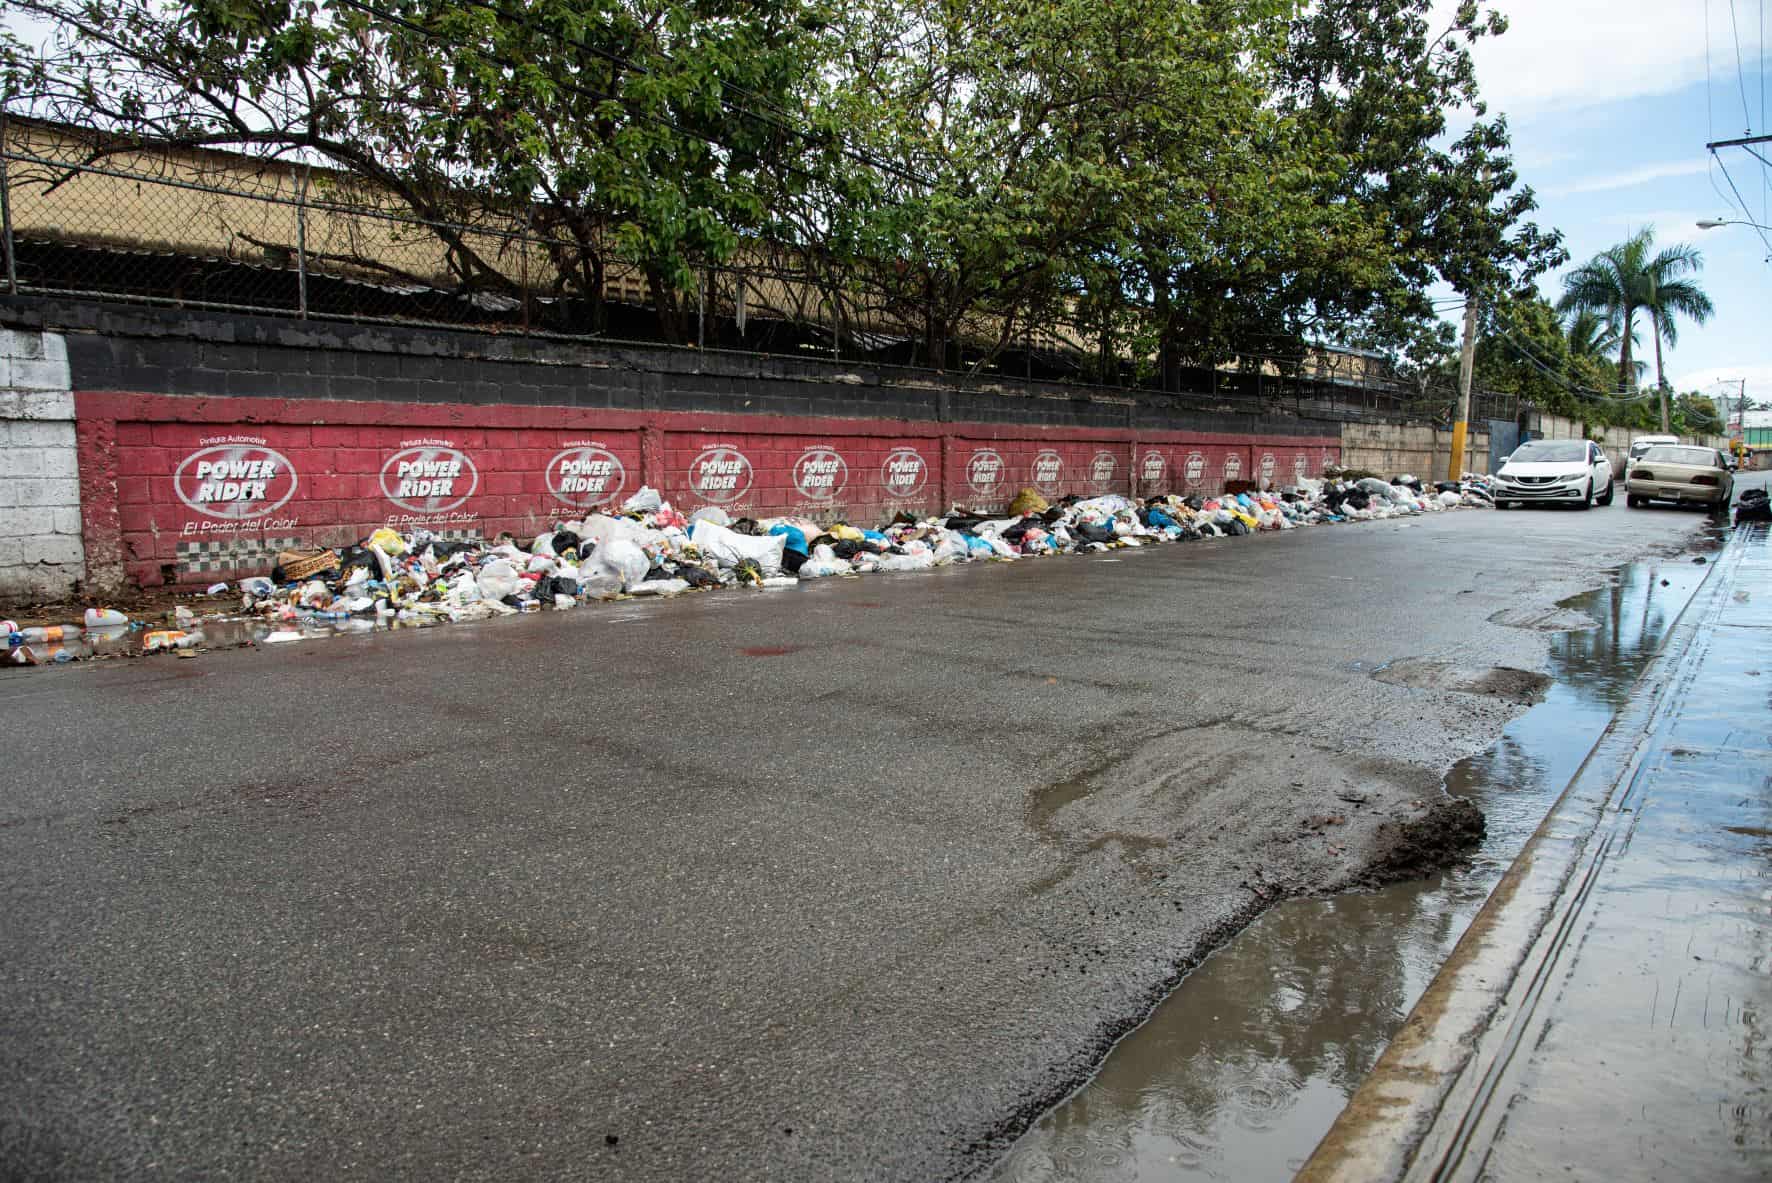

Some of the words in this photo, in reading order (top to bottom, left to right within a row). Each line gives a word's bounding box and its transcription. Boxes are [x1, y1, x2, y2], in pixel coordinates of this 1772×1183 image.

[196, 460, 277, 480] POWER
[397, 460, 461, 479] POWER
[560, 460, 614, 477] POWER
[700, 460, 742, 475] POWER
[803, 460, 840, 474] POWER
[889, 460, 921, 473] POWER
[972, 460, 999, 472] POWER
[399, 479, 454, 497] RIDER
[560, 477, 606, 493] RIDER
[700, 475, 737, 489] RIDER
[803, 474, 835, 488] RIDER
[199, 481, 267, 503] RIDER
[200, 520, 238, 534] Poder
[241, 518, 261, 532] del
[400, 514, 432, 525] Poder
[433, 512, 449, 524] del
